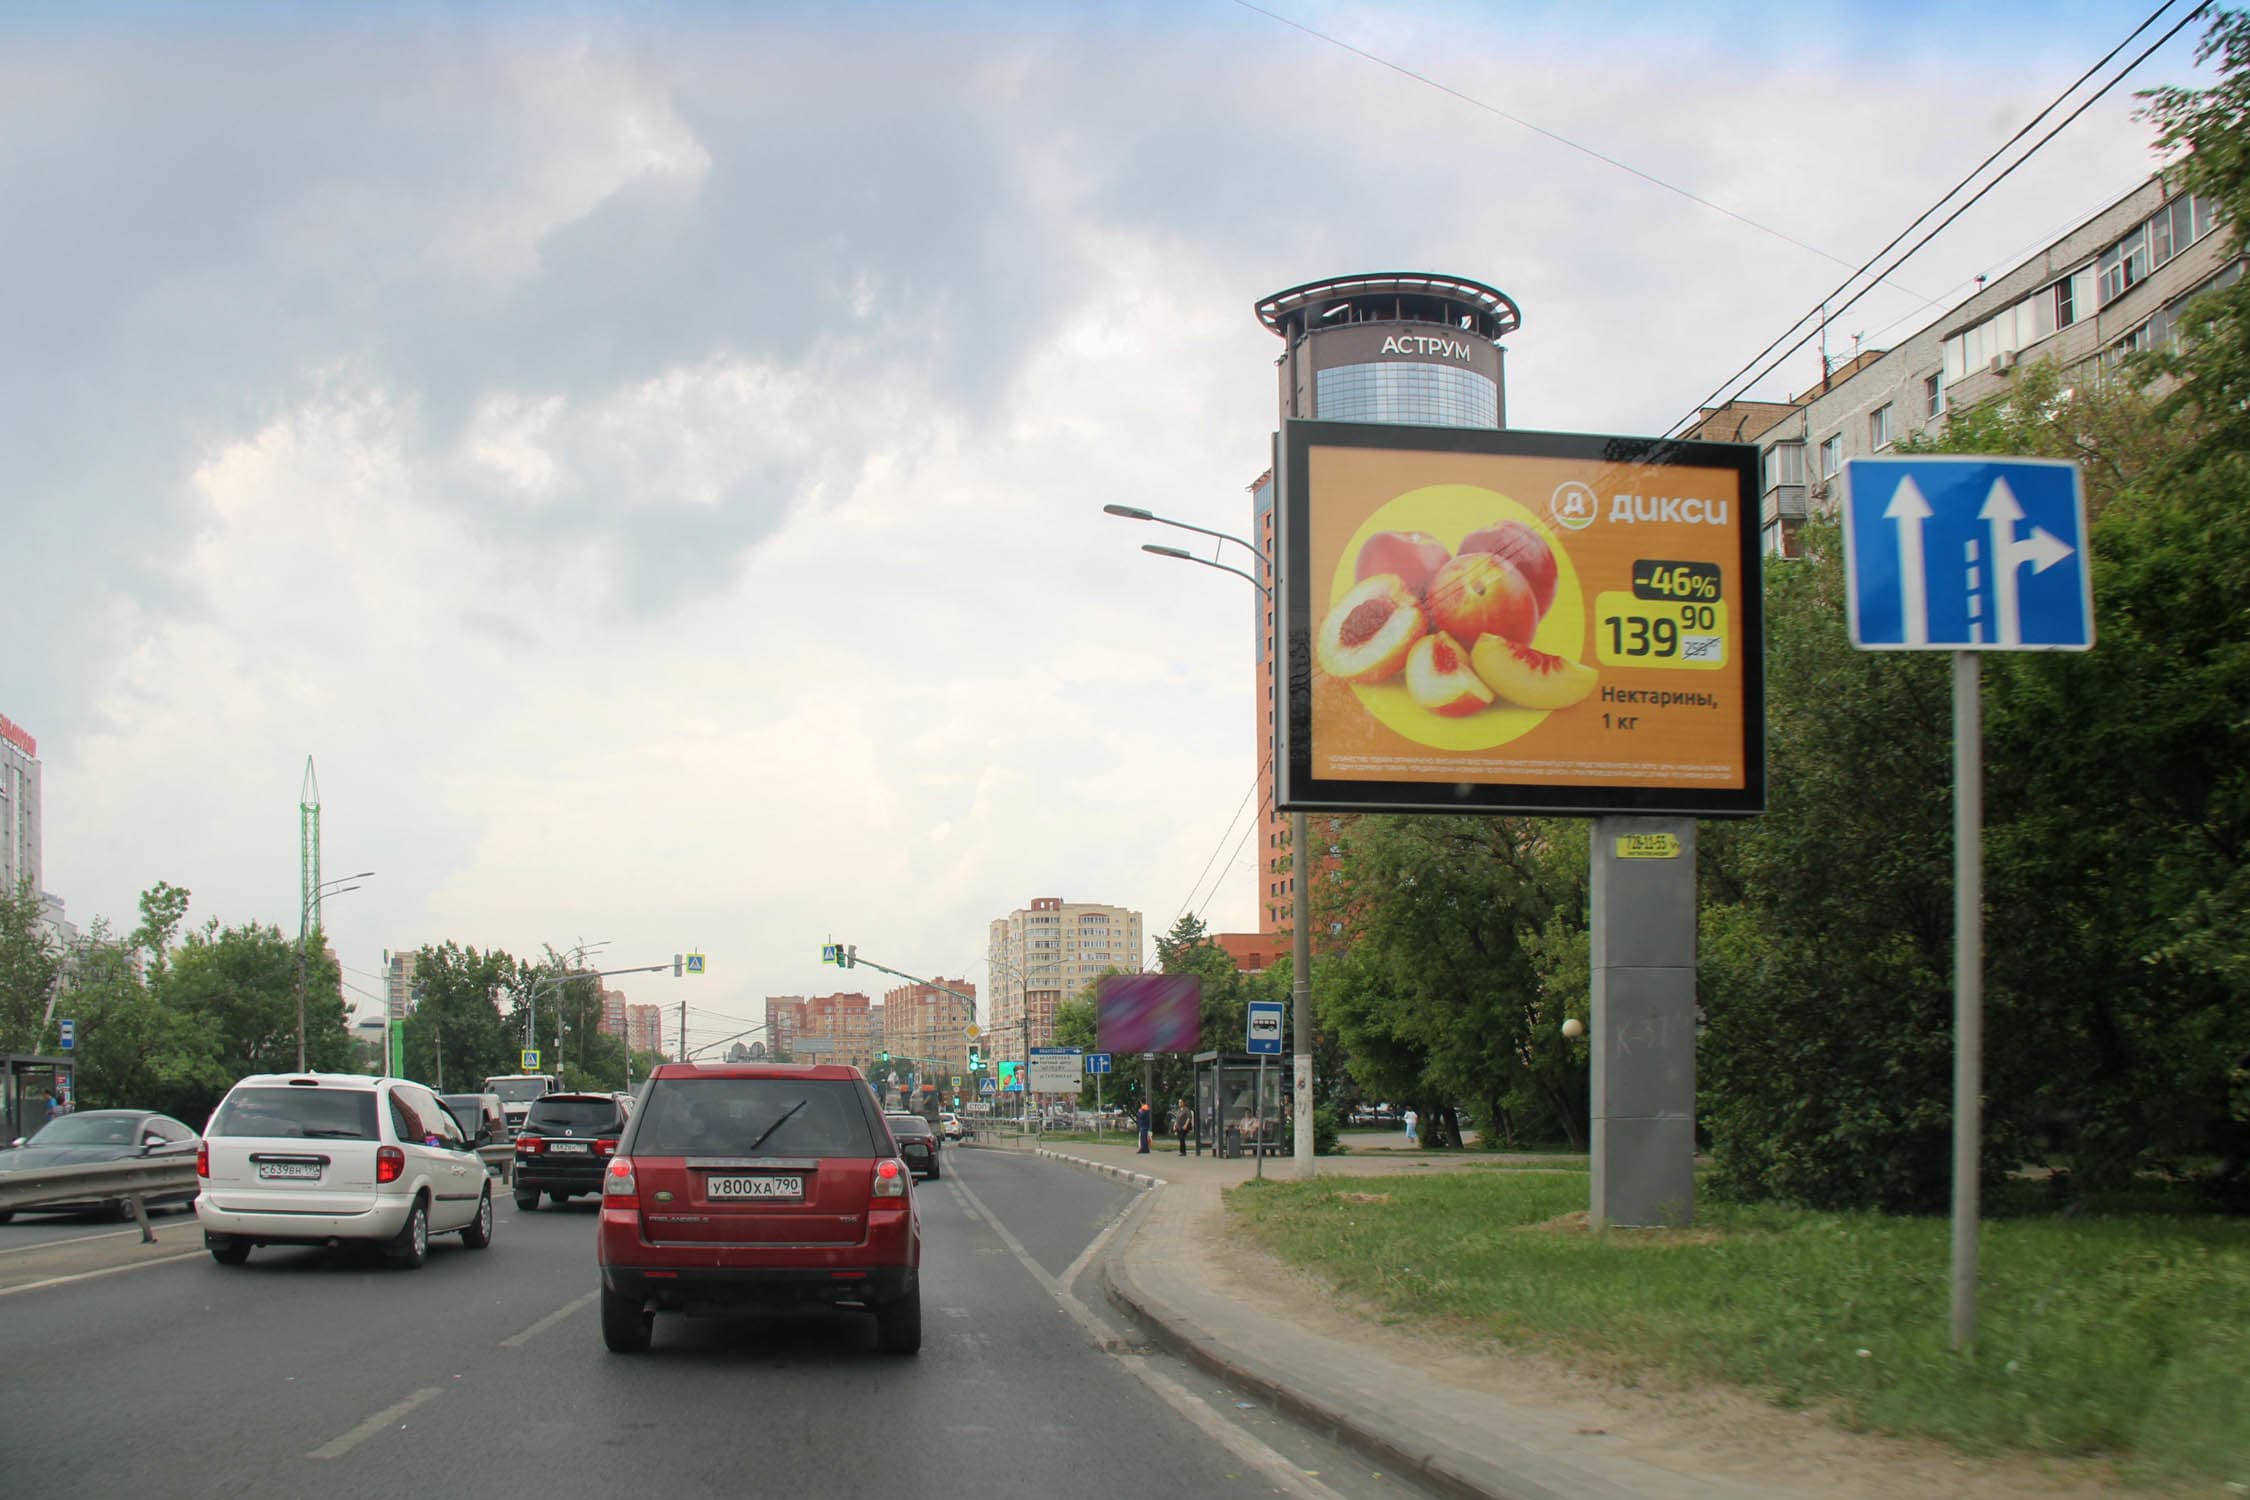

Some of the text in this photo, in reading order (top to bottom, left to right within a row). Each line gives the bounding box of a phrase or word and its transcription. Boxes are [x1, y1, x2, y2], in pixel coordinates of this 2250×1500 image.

[1381, 335, 1470, 361] АСТРУМ
[1635, 566, 1717, 598] -46%
[1604, 605, 1715, 657] 139 90
[1602, 686, 1718, 709] Нектарины,
[1602, 713, 1638, 729] 1 кг
[713, 1177, 799, 1194] У800ХА 790
